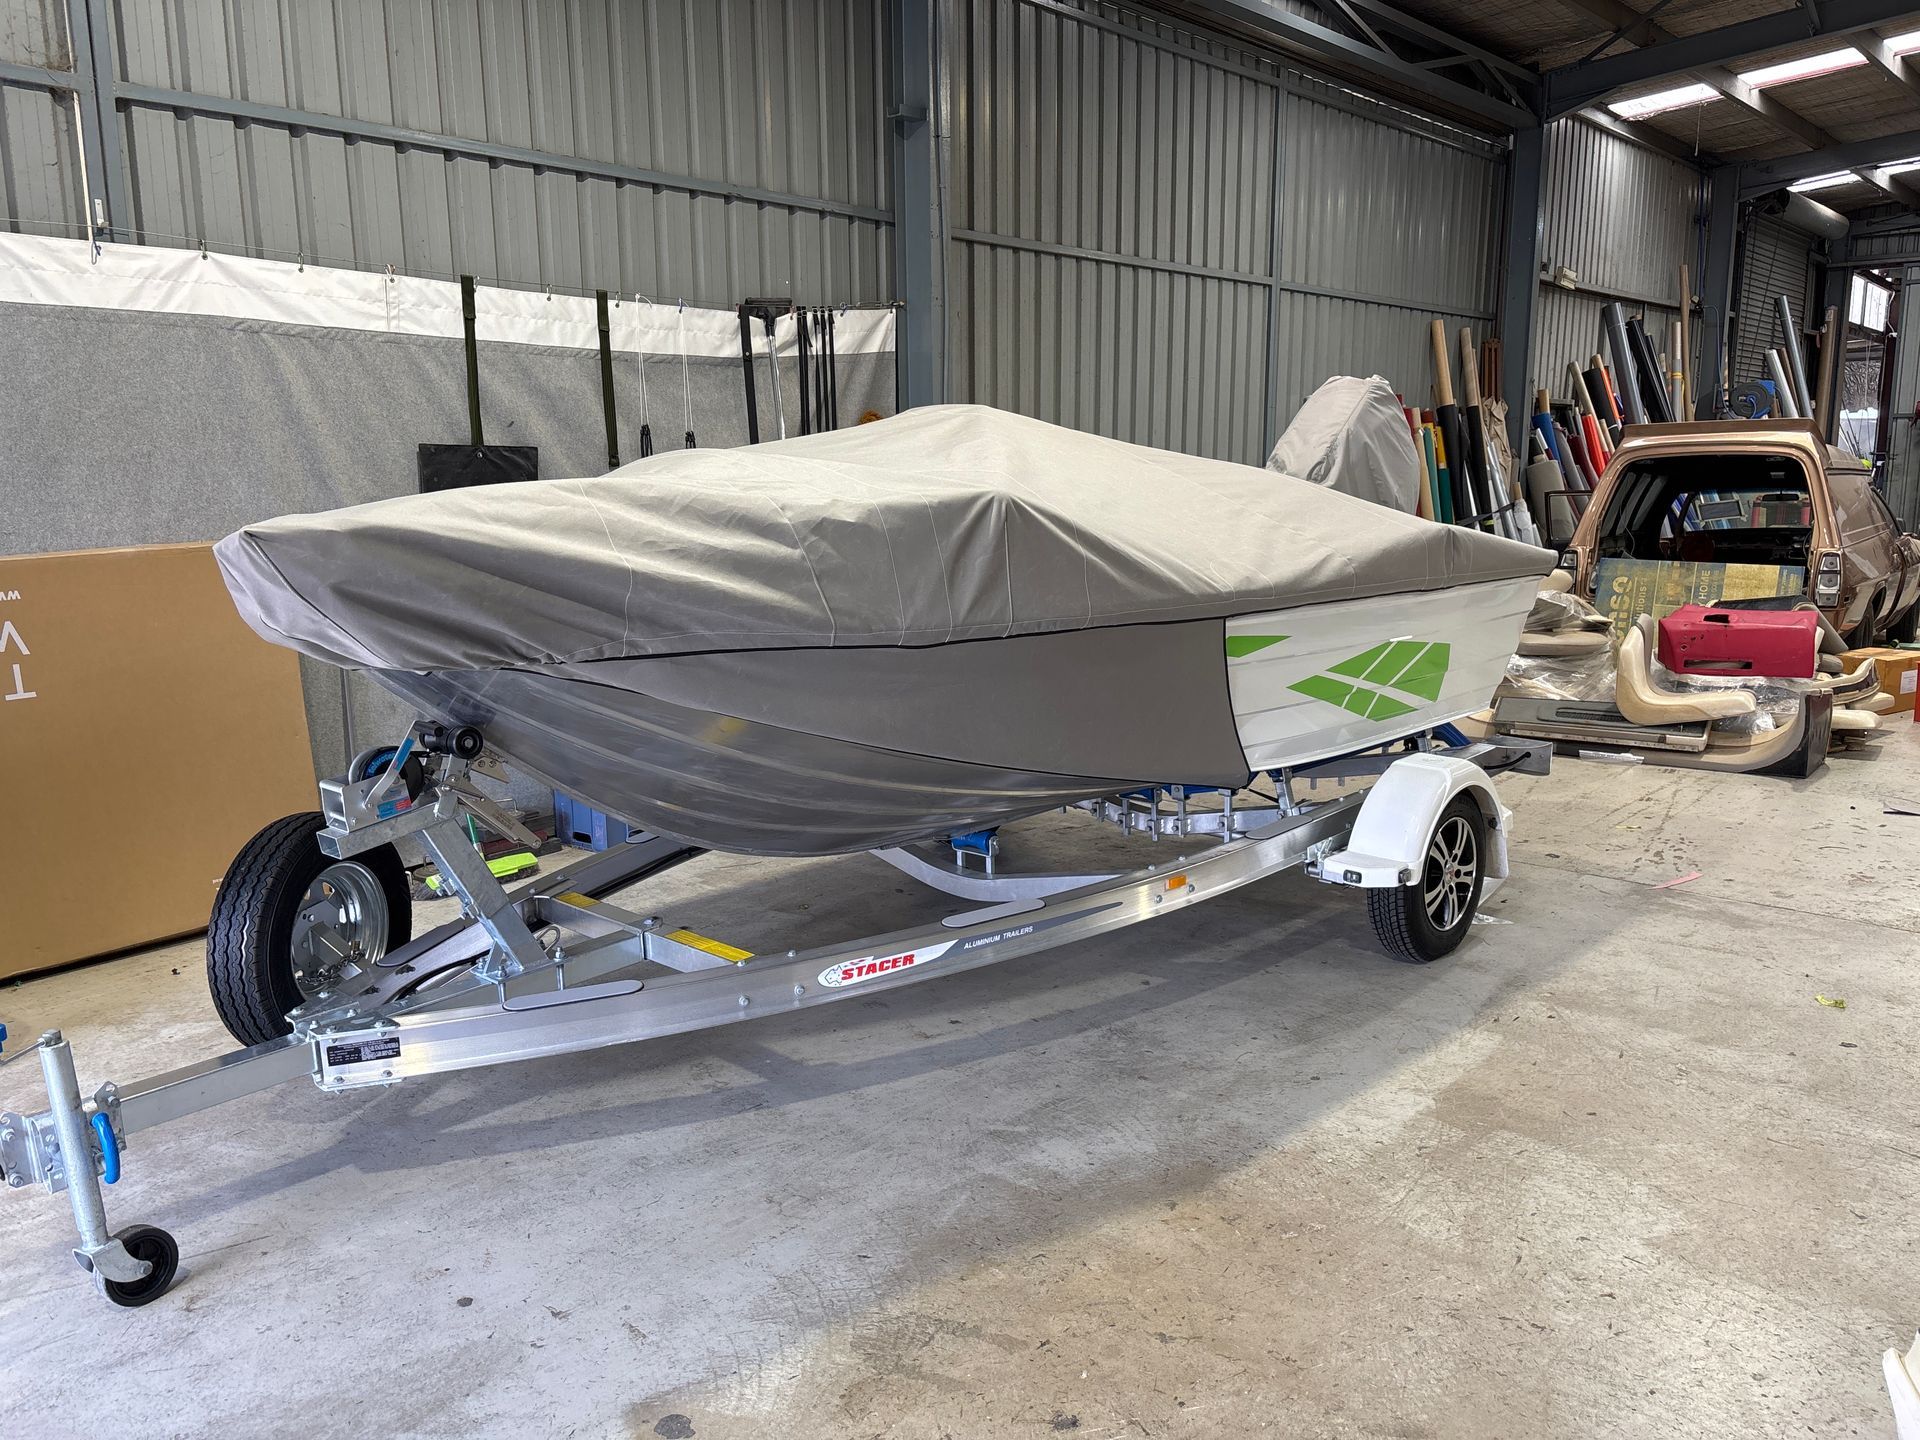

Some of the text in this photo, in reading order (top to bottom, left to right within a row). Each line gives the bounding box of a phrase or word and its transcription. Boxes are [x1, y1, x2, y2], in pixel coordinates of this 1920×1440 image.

[963, 925, 1034, 949] ALUMINIUM TRAILERS
[841, 954, 915, 981] STACER
